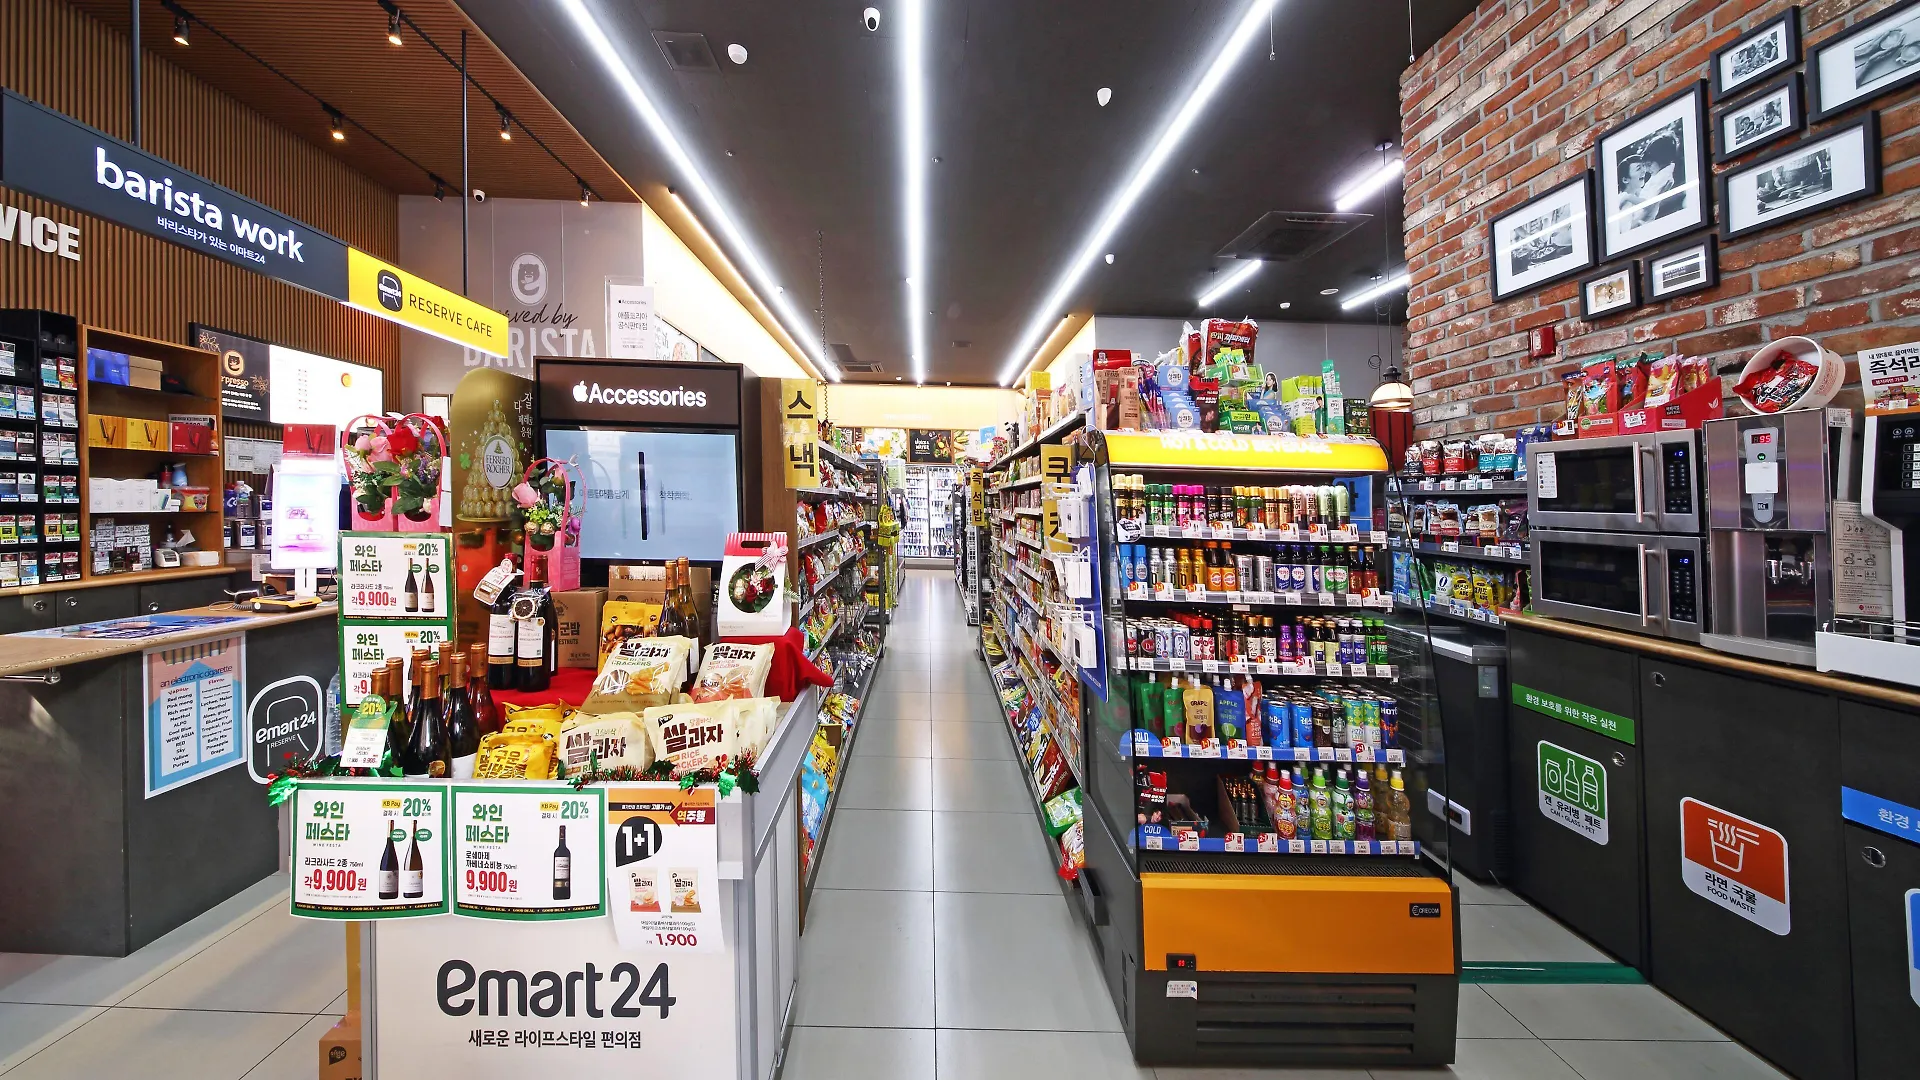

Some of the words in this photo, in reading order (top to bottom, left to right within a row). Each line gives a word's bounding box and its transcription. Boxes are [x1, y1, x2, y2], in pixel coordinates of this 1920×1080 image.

[97, 146, 222, 231] barista
[233, 212, 304, 262] work
[157, 215, 207, 244] 바리스타가
[209, 232, 227, 250] 있는
[229, 243, 266, 265] 이마트24
[409, 293, 462, 326] RESERVE
[466, 317, 492, 337] CAFE
[551, 303, 578, 338] by
[588, 382, 707, 407] Accessories
[787, 390, 815, 477] 스낵
[485, 454, 511, 466] FERRERO
[486, 464, 511, 475] ROCHER
[971, 471, 982, 522] 즉석밥
[354, 544, 376, 557] 와인
[418, 543, 438, 556] 20%
[350, 559, 382, 572] 페스타
[420, 630, 440, 644] 20%
[559, 622, 580, 636] 군밤
[356, 632, 378, 646] 와인
[352, 648, 384, 660] 페스타
[713, 644, 756, 660] 쌀과자
[170, 672, 204, 686] electronic
[204, 666, 232, 678] cigarette
[362, 702, 382, 715] 20%
[1526, 693, 1540, 706] 환경
[1542, 698, 1562, 714] 보호를
[1564, 706, 1580, 719] 위한
[1582, 711, 1598, 724] 작은
[1600, 718, 1616, 732] 실천
[270, 735, 296, 749] RESERVE
[663, 723, 724, 754] 쌀과자
[172, 754, 188, 762] Yellow
[566, 732, 626, 766] 쌀과자
[682, 750, 700, 760] RICE
[172, 760, 190, 768] Purple
[313, 800, 344, 819] 와인
[391, 800, 400, 808] Pay
[402, 798, 432, 817] 20%
[472, 804, 502, 822] 와인
[561, 800, 589, 819] 20%
[1544, 794, 1552, 806] 캔
[1556, 801, 1580, 820] 유리병
[1584, 814, 1602, 830] 페트
[677, 810, 706, 822] 역주행
[1550, 808, 1560, 818] CAN
[1564, 815, 1580, 827] GLASS
[1586, 825, 1595, 834] PET
[1878, 807, 1910, 829] 환경
[306, 822, 350, 841] 페스타
[466, 825, 510, 844] 페스타
[622, 823, 655, 856] 1+1
[1144, 826, 1162, 834] COLD
[304, 857, 336, 867] 라크라사드
[337, 858, 348, 867] 2종
[304, 868, 367, 892] 각9,900원
[466, 869, 517, 892] 9,900원
[1705, 871, 1728, 892] 라면
[1732, 884, 1757, 906] 국물
[1707, 885, 1728, 901] FOOD
[1729, 896, 1756, 915] WASTE
[656, 933, 697, 946] 1,900
[436, 959, 677, 1020] emart24
[468, 1030, 510, 1048] 새로운
[514, 1030, 596, 1049] 라이프스타일
[601, 1030, 642, 1049] 편의점
